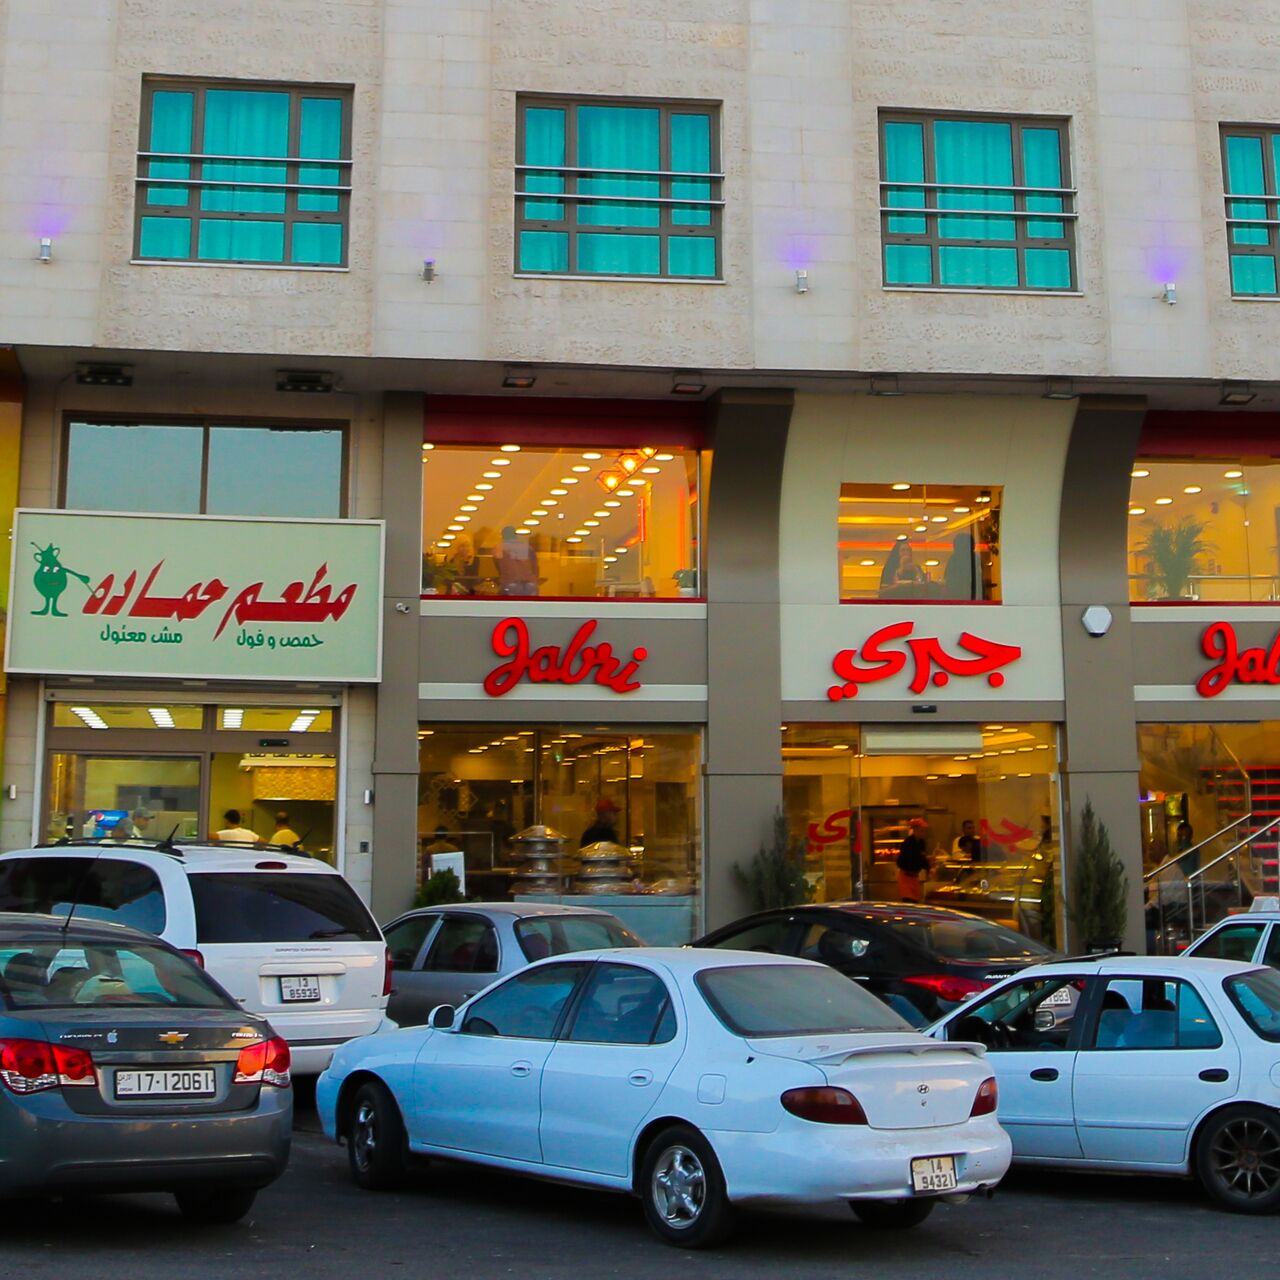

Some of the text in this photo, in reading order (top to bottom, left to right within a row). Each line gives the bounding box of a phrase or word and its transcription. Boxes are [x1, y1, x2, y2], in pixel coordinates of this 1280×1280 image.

[213, 561, 359, 642] مطعم
[150, 626, 183, 643] مش
[236, 628, 265, 649] فول
[267, 635, 276, 650] و
[484, 616, 648, 698] Jabri
[827, 620, 1022, 702] جبري
[137, 1072, 210, 1092] 17-12061
[921, 1173, 954, 1189] 94321
